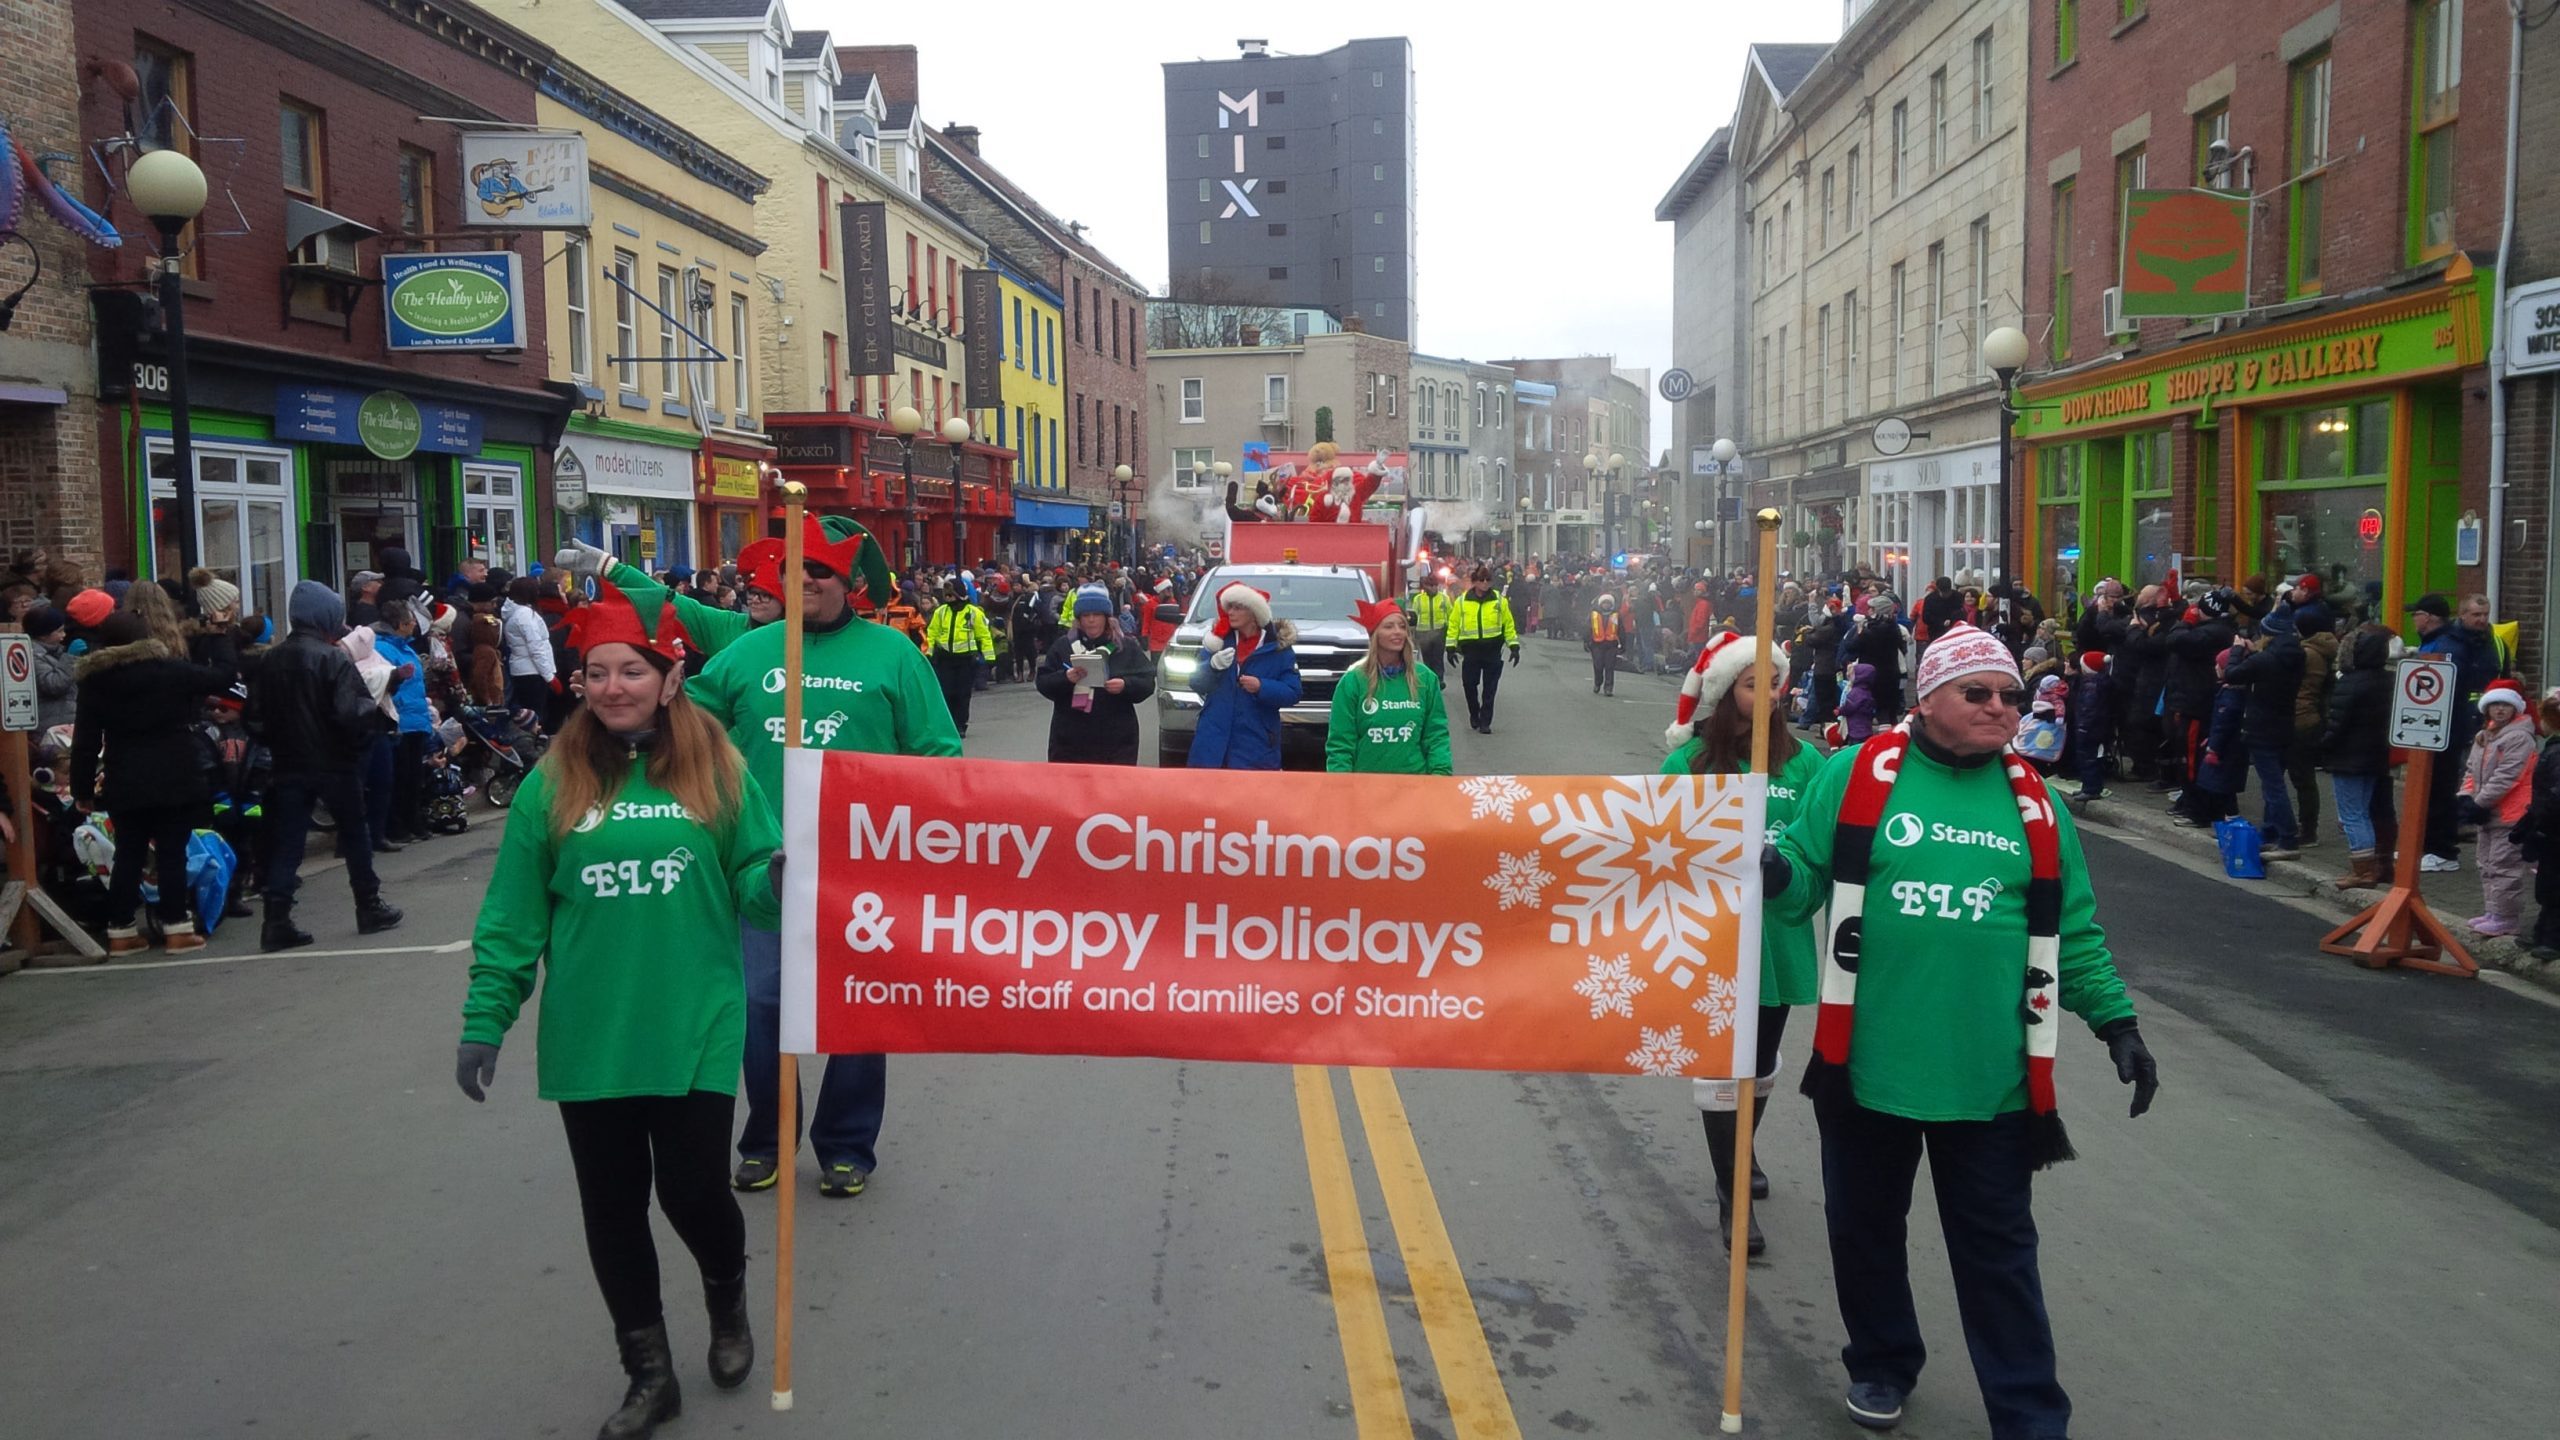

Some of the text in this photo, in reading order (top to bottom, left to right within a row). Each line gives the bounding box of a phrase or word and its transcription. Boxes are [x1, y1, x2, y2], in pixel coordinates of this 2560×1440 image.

[1218, 88, 1261, 218] MIX
[392, 265, 418, 281] Health
[419, 260, 438, 270] Food
[447, 259, 482, 269] Wellness
[484, 264, 505, 278] Store
[401, 289, 500, 310] The Healthy Vibe
[134, 362, 168, 391] 306
[2062, 333, 2382, 424] DOWNHOME SHOPPE & GALLERY
[801, 673, 863, 692] tantec
[1381, 699, 1421, 710] Stantec
[1368, 727, 1413, 743] ELF
[850, 803, 1426, 881] Merry Christmas
[1930, 822, 2021, 855] Stantec
[581, 860, 686, 897] ELF
[1891, 880, 1994, 922] ELF
[844, 891, 1484, 978] & Happy Holidays
[844, 975, 1484, 1021] from the staff and families of Stantec
